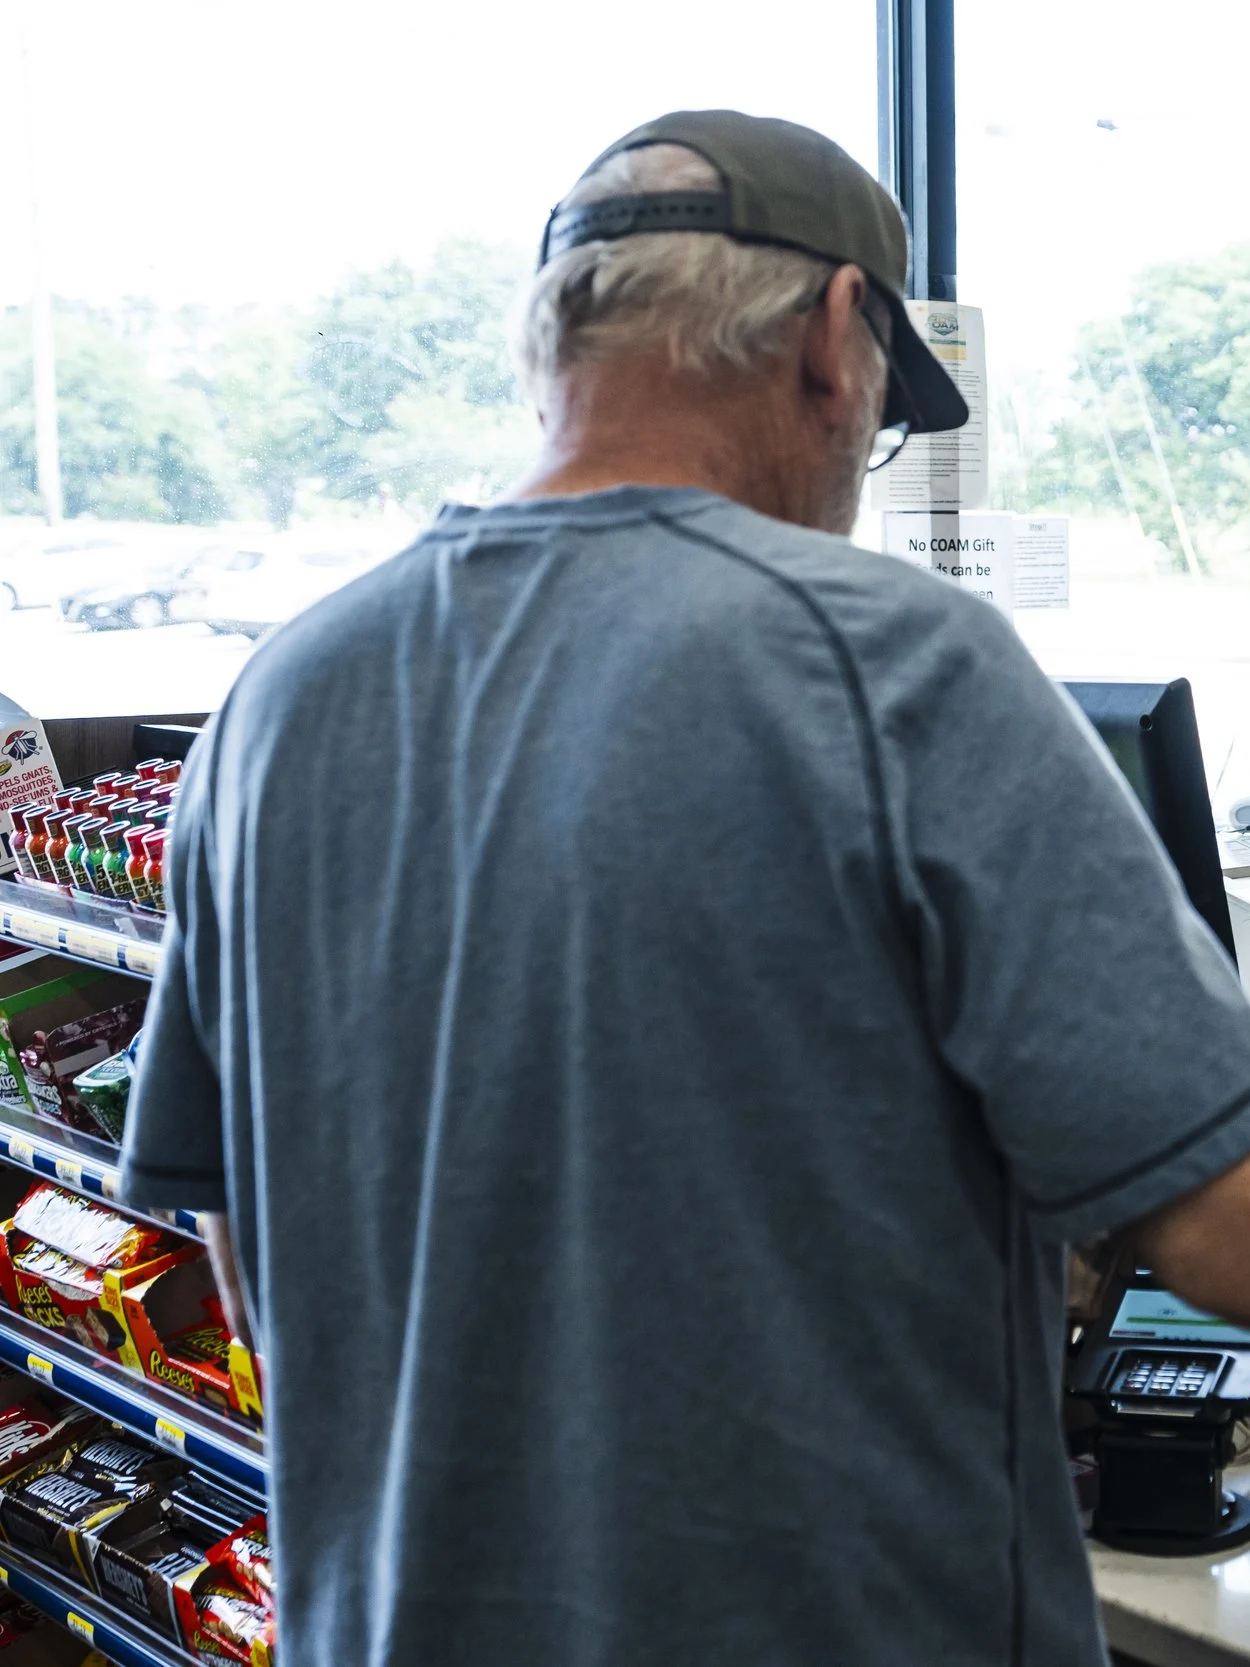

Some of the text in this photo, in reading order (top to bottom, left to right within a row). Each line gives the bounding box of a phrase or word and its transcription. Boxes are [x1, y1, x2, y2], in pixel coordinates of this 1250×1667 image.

[909, 539, 995, 552] No COAM Gift
[951, 566, 971, 576] can
[977, 563, 990, 576] be
[22, 766, 52, 781] GNATS,
[0, 776, 56, 800] MOSQUITOES,
[15, 1274, 52, 1304] Reese's
[150, 1351, 195, 1392] Reese's
